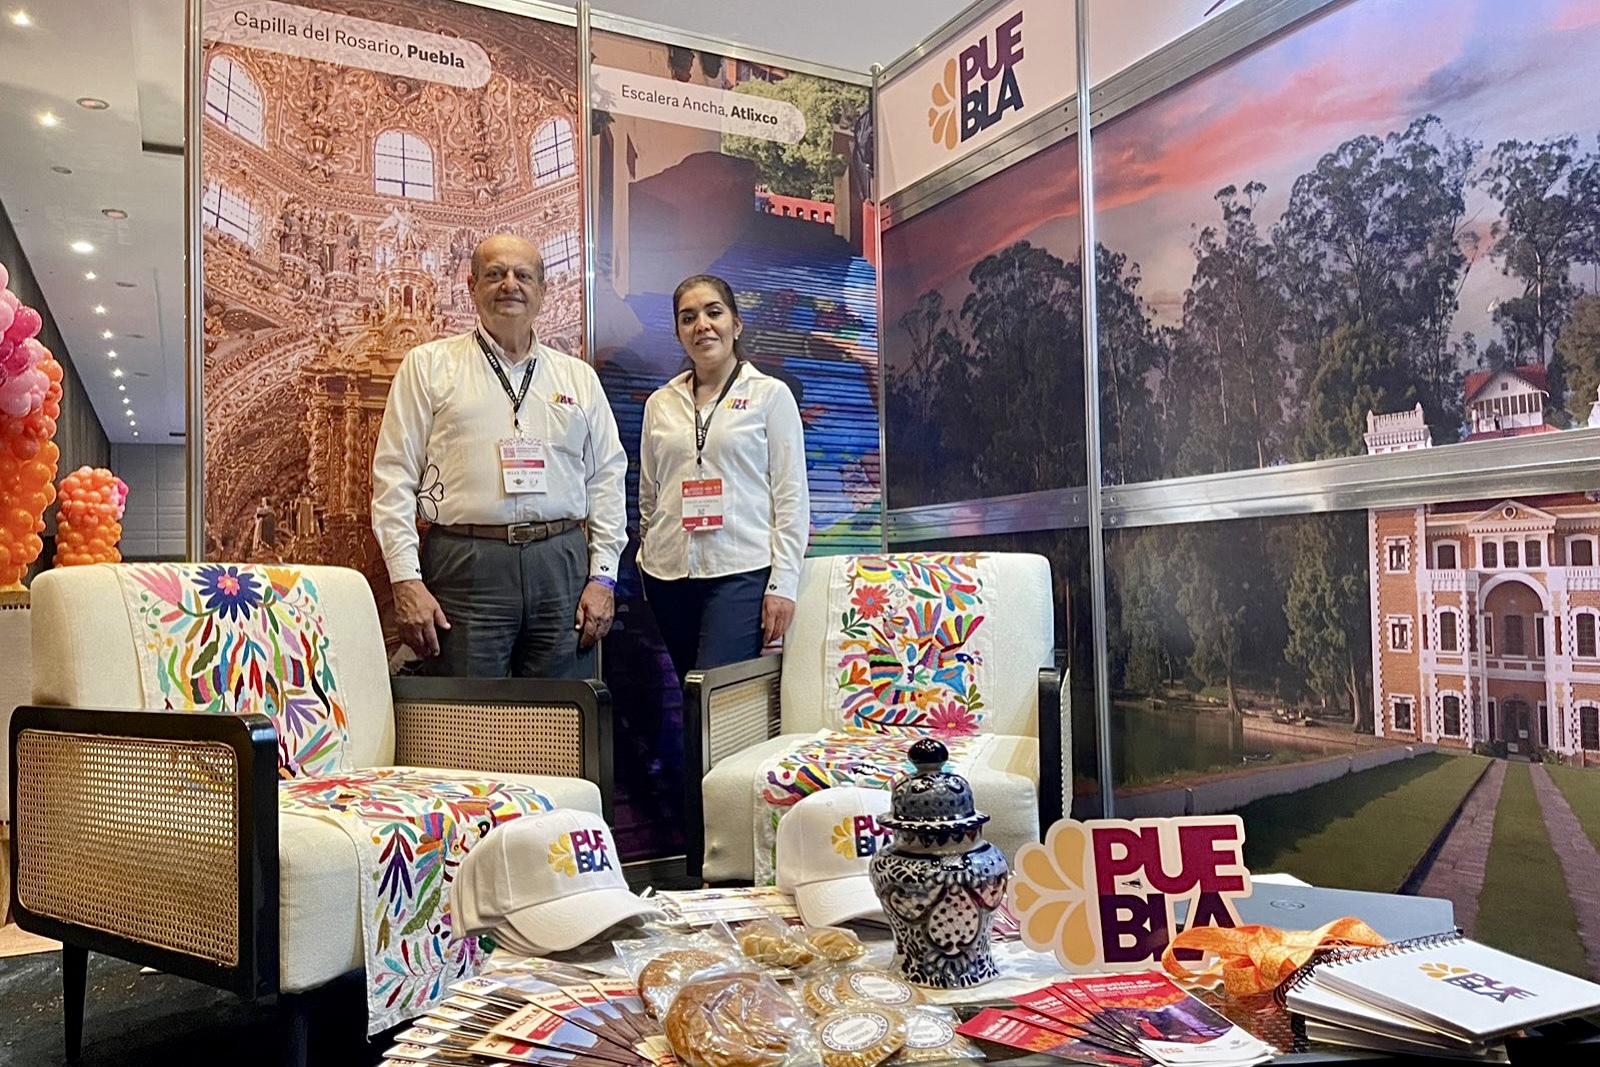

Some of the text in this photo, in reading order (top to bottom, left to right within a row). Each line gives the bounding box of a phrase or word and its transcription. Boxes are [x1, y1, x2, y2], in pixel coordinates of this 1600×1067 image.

[234, 11, 465, 69] Capilla del Rosario, Puebla
[621, 84, 778, 125] Escalera Ancha, Atlixco
[570, 829, 608, 853] PUE
[1092, 824, 1245, 895] PUE
[575, 850, 613, 874] BLA
